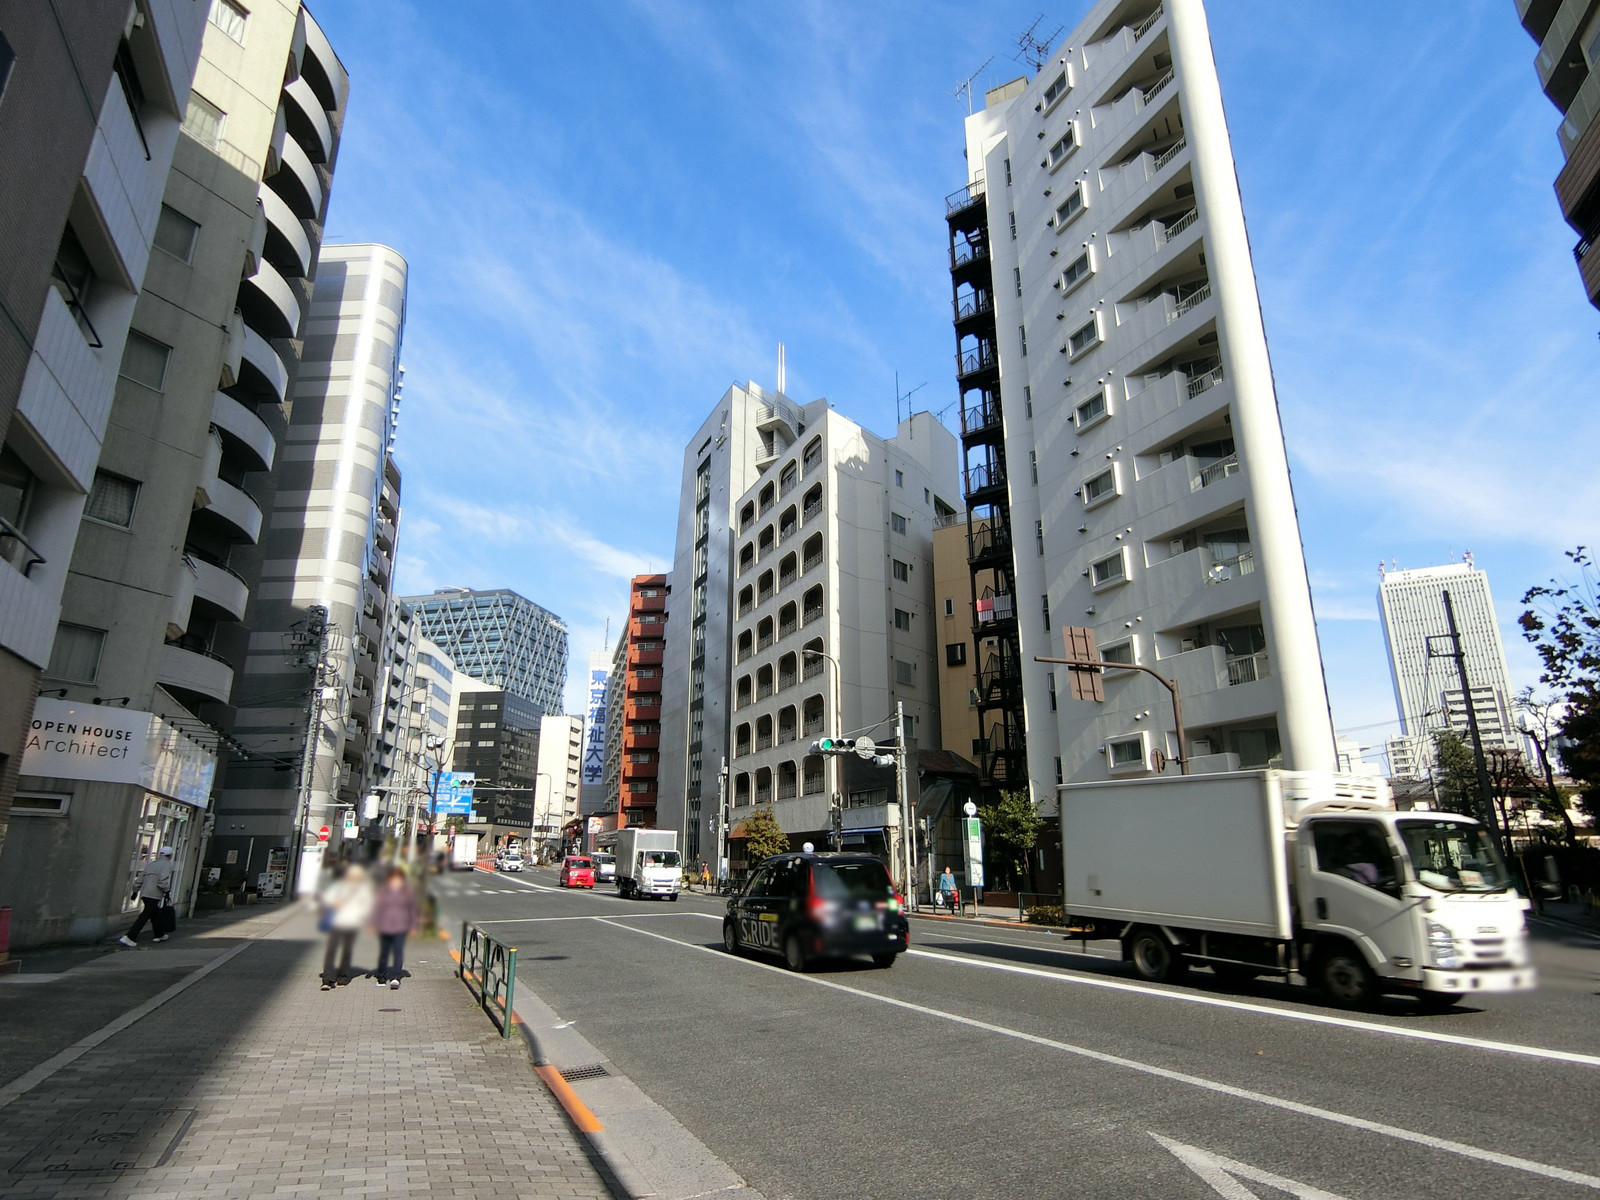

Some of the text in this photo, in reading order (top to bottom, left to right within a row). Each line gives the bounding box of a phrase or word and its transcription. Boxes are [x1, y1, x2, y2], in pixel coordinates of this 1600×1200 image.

[32, 720, 132, 741] OPEN HOUSE
[585, 669, 608, 782] 東京福祉大学
[26, 735, 129, 759] Architect
